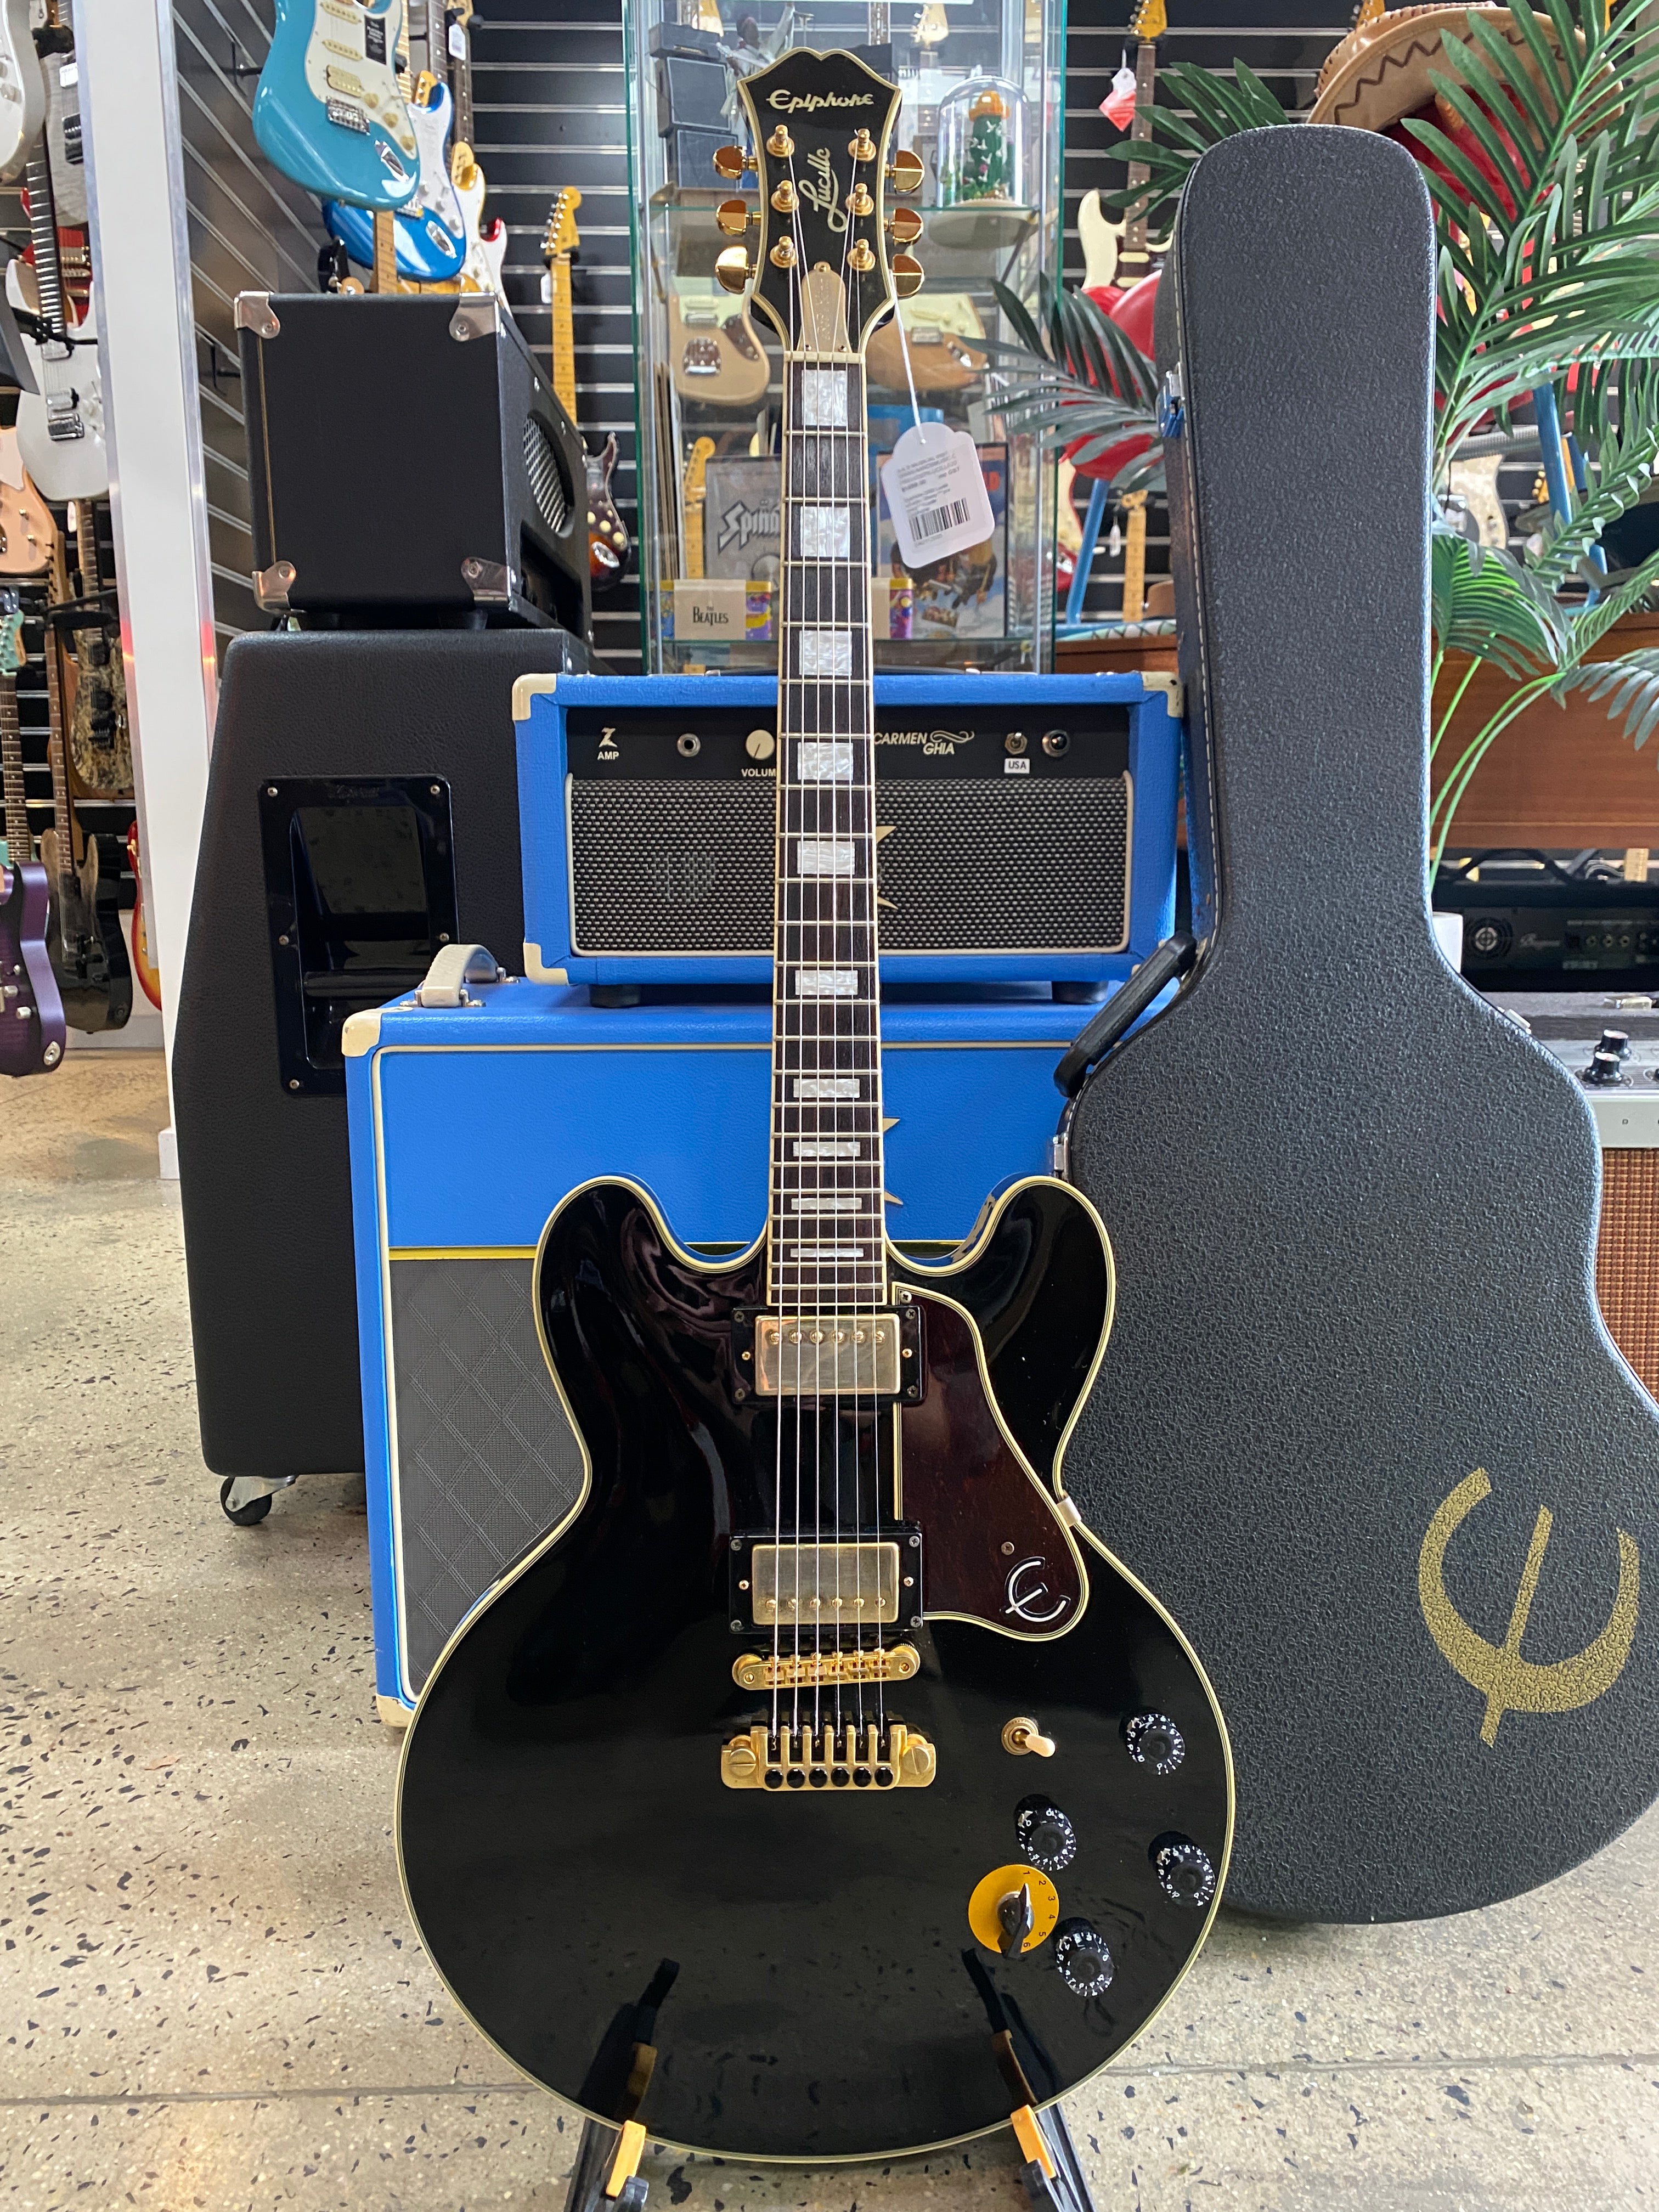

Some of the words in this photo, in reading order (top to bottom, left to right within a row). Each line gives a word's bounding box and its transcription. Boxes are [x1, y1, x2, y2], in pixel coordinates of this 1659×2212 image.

[766, 89, 874, 114] Epiphone
[798, 148, 848, 233] Lucille
[693, 606, 729, 627] BEATLES
[874, 732, 927, 745] CARMEN
[923, 742, 955, 755] GHIA
[597, 751, 619, 760] AMP
[1008, 760, 1026, 769] USA
[741, 768, 776, 777] VOLUM
